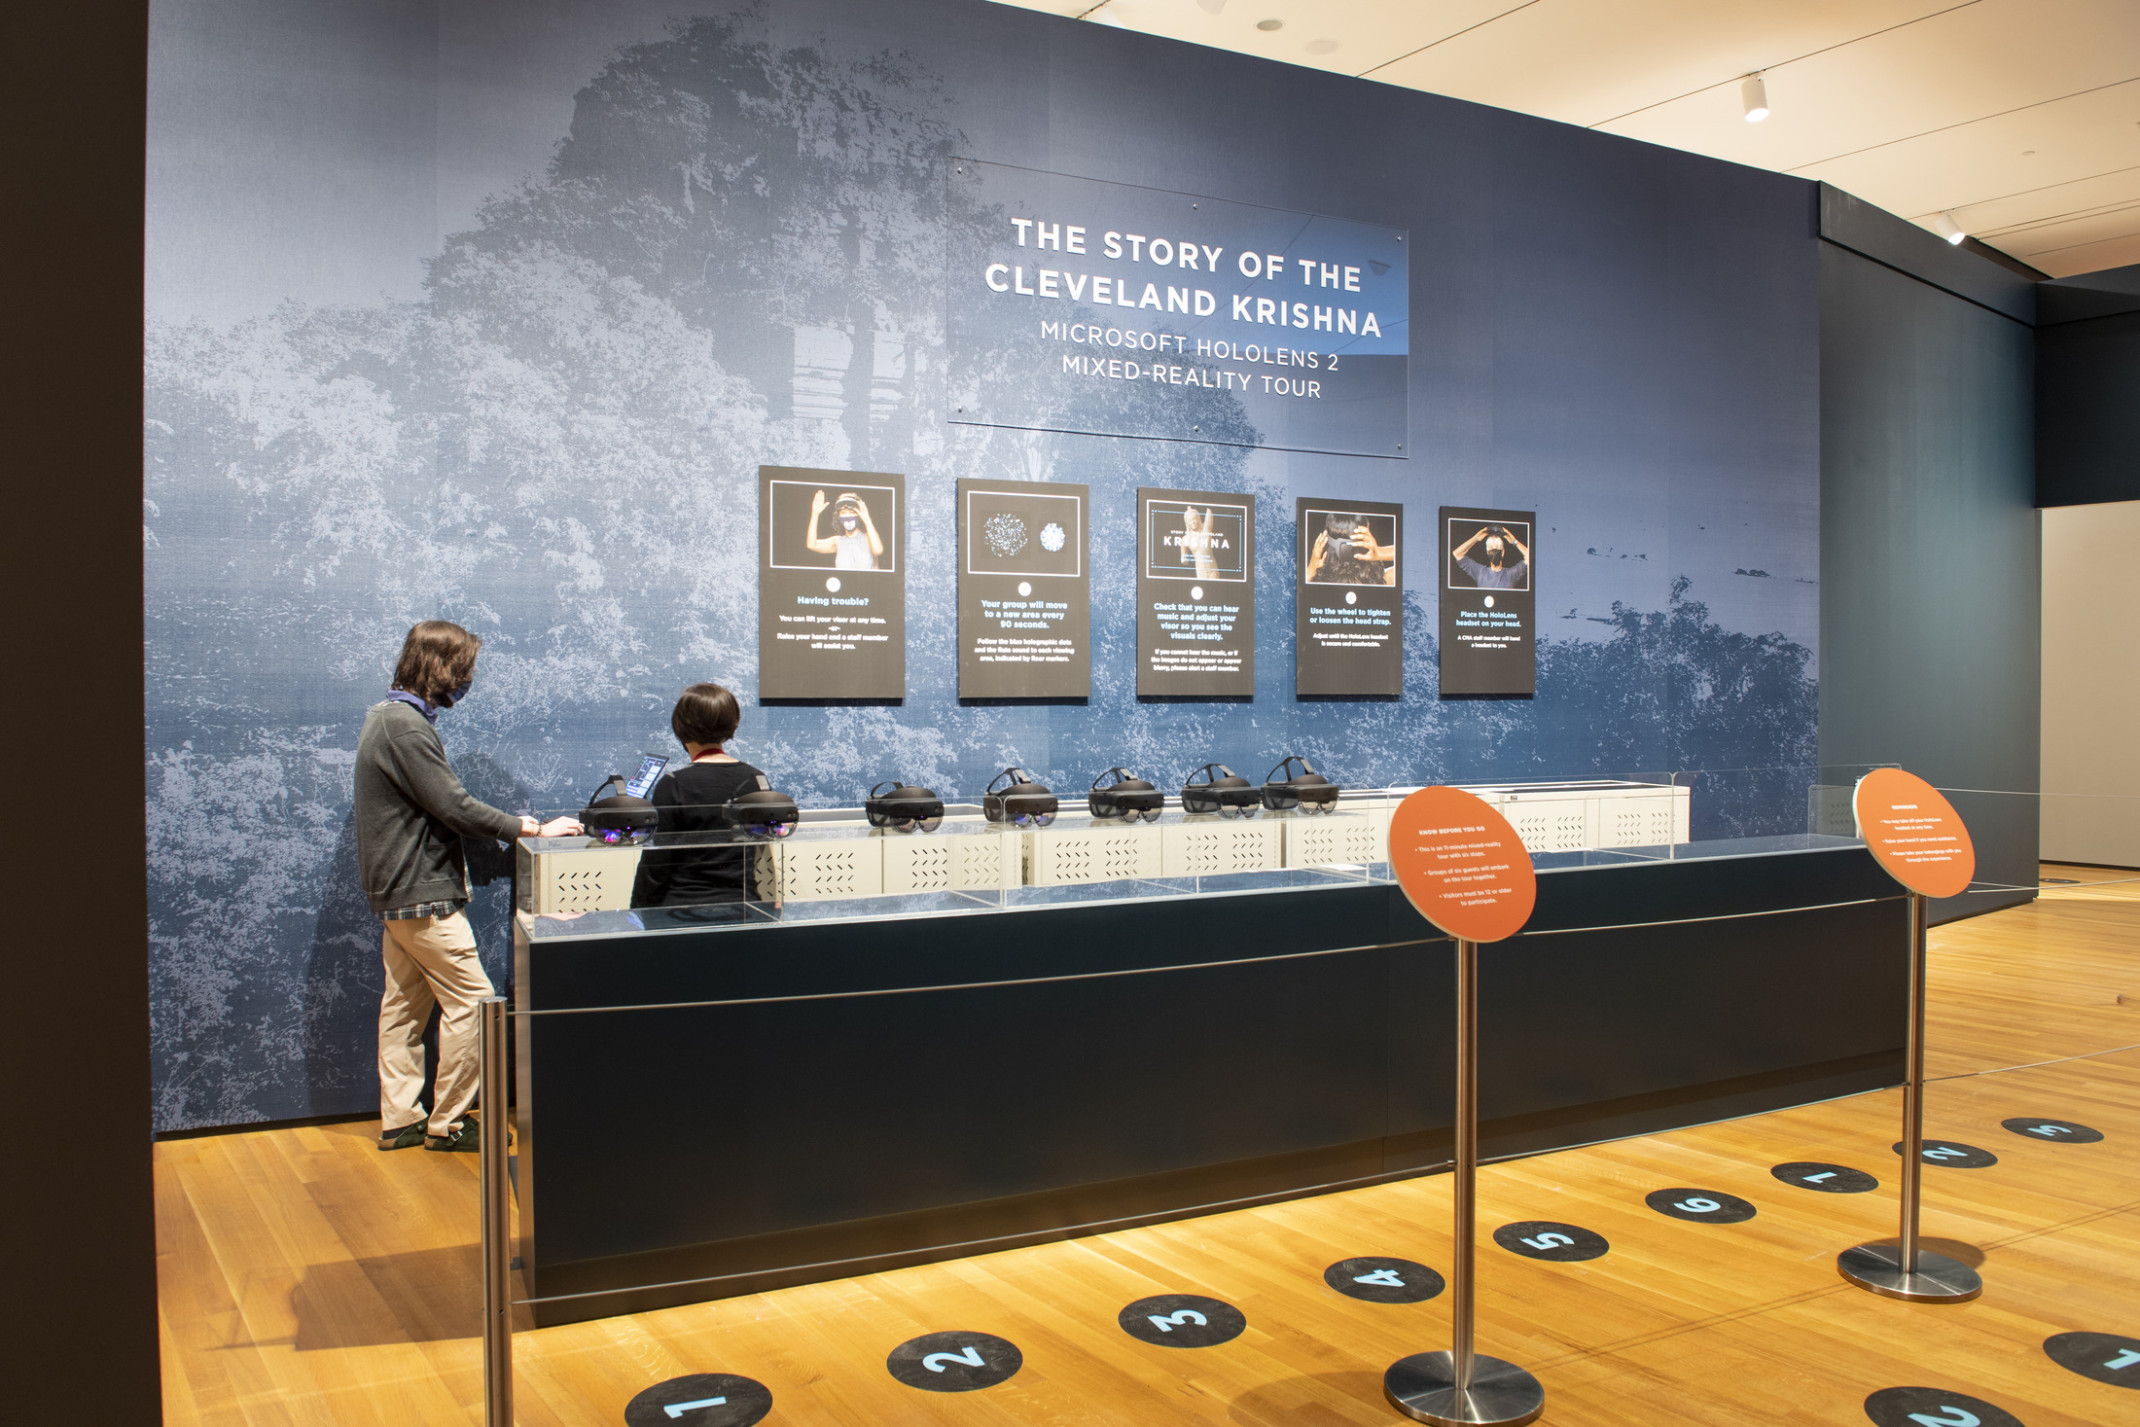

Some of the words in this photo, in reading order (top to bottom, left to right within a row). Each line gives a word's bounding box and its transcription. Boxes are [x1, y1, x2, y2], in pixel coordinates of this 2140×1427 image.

[1011, 217, 1086, 255] THE
[1103, 231, 1223, 272] STORY
[1238, 250, 1284, 281] OF
[1298, 258, 1361, 292] THE
[985, 263, 1216, 317] CLEVELAND
[1233, 294, 1382, 338] KRISHNA
[1040, 320, 1187, 354] MICROSOFT
[1197, 338, 1319, 369] HOLOLENS
[1328, 353, 1339, 371] 2
[1062, 355, 1252, 392] MIXED-REALITY
[1261, 375, 1321, 399] TOUR
[1163, 535, 1230, 550] KRISHNA
[797, 596, 829, 605] Having
[831, 597, 869, 605] trouble?
[981, 600, 1000, 608] Your
[1003, 601, 1027, 609] group
[1042, 612, 1064, 620] every
[1196, 614, 1218, 622] adjust
[1368, 609, 1390, 617] tighten
[1000, 620, 1012, 628] 90
[1197, 633, 1223, 641] clearly.
[2027, 1125, 2072, 1136] 3
[1922, 1147, 1968, 1160] 2
[1802, 1172, 1838, 1183] 1
[1673, 1197, 1721, 1213] 6
[1522, 1232, 1574, 1250] 5
[1353, 1269, 1406, 1287] 4
[1147, 1309, 1207, 1333] 3
[922, 1346, 986, 1374] 2
[663, 1396, 727, 1419] 1
